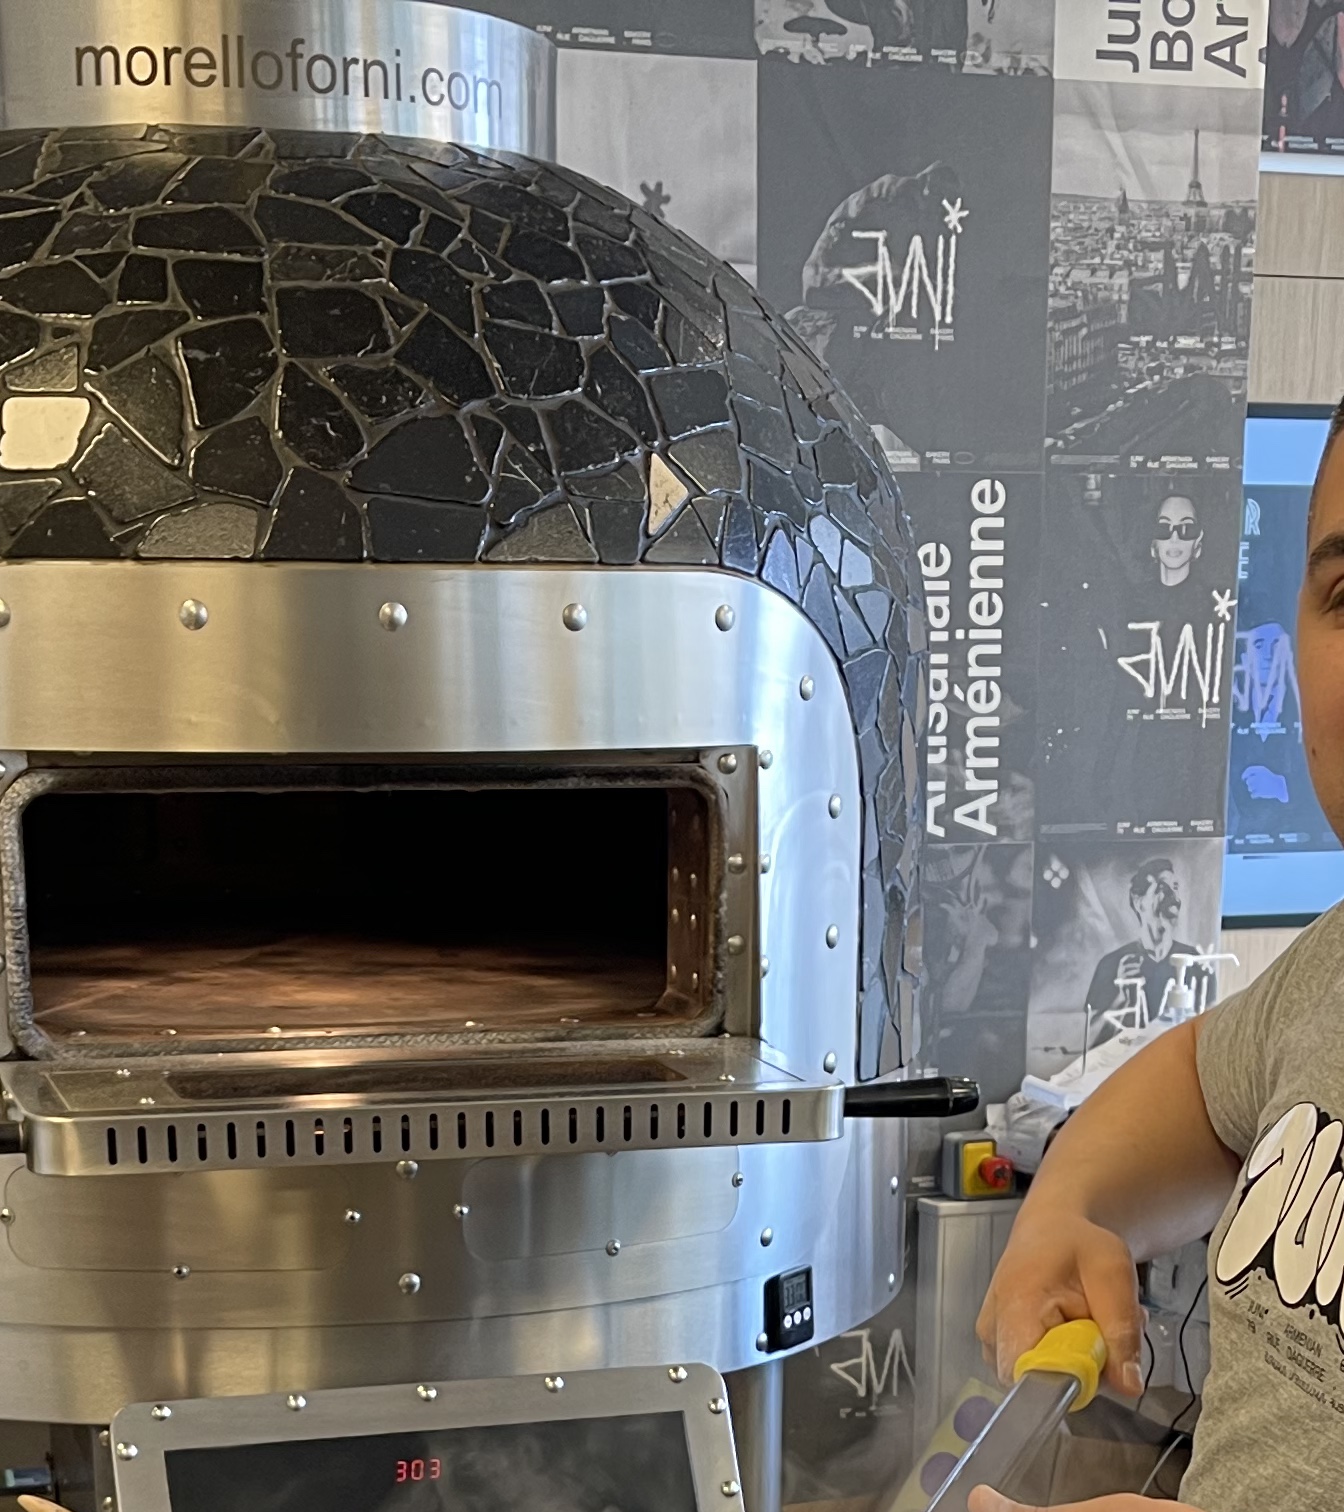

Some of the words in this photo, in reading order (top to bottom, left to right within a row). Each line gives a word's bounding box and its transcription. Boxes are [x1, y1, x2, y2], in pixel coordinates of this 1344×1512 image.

[74, 33, 503, 121] morelloforni.com
[954, 478, 1007, 836] Arménienne
[396, 1458, 441, 1483] 303
